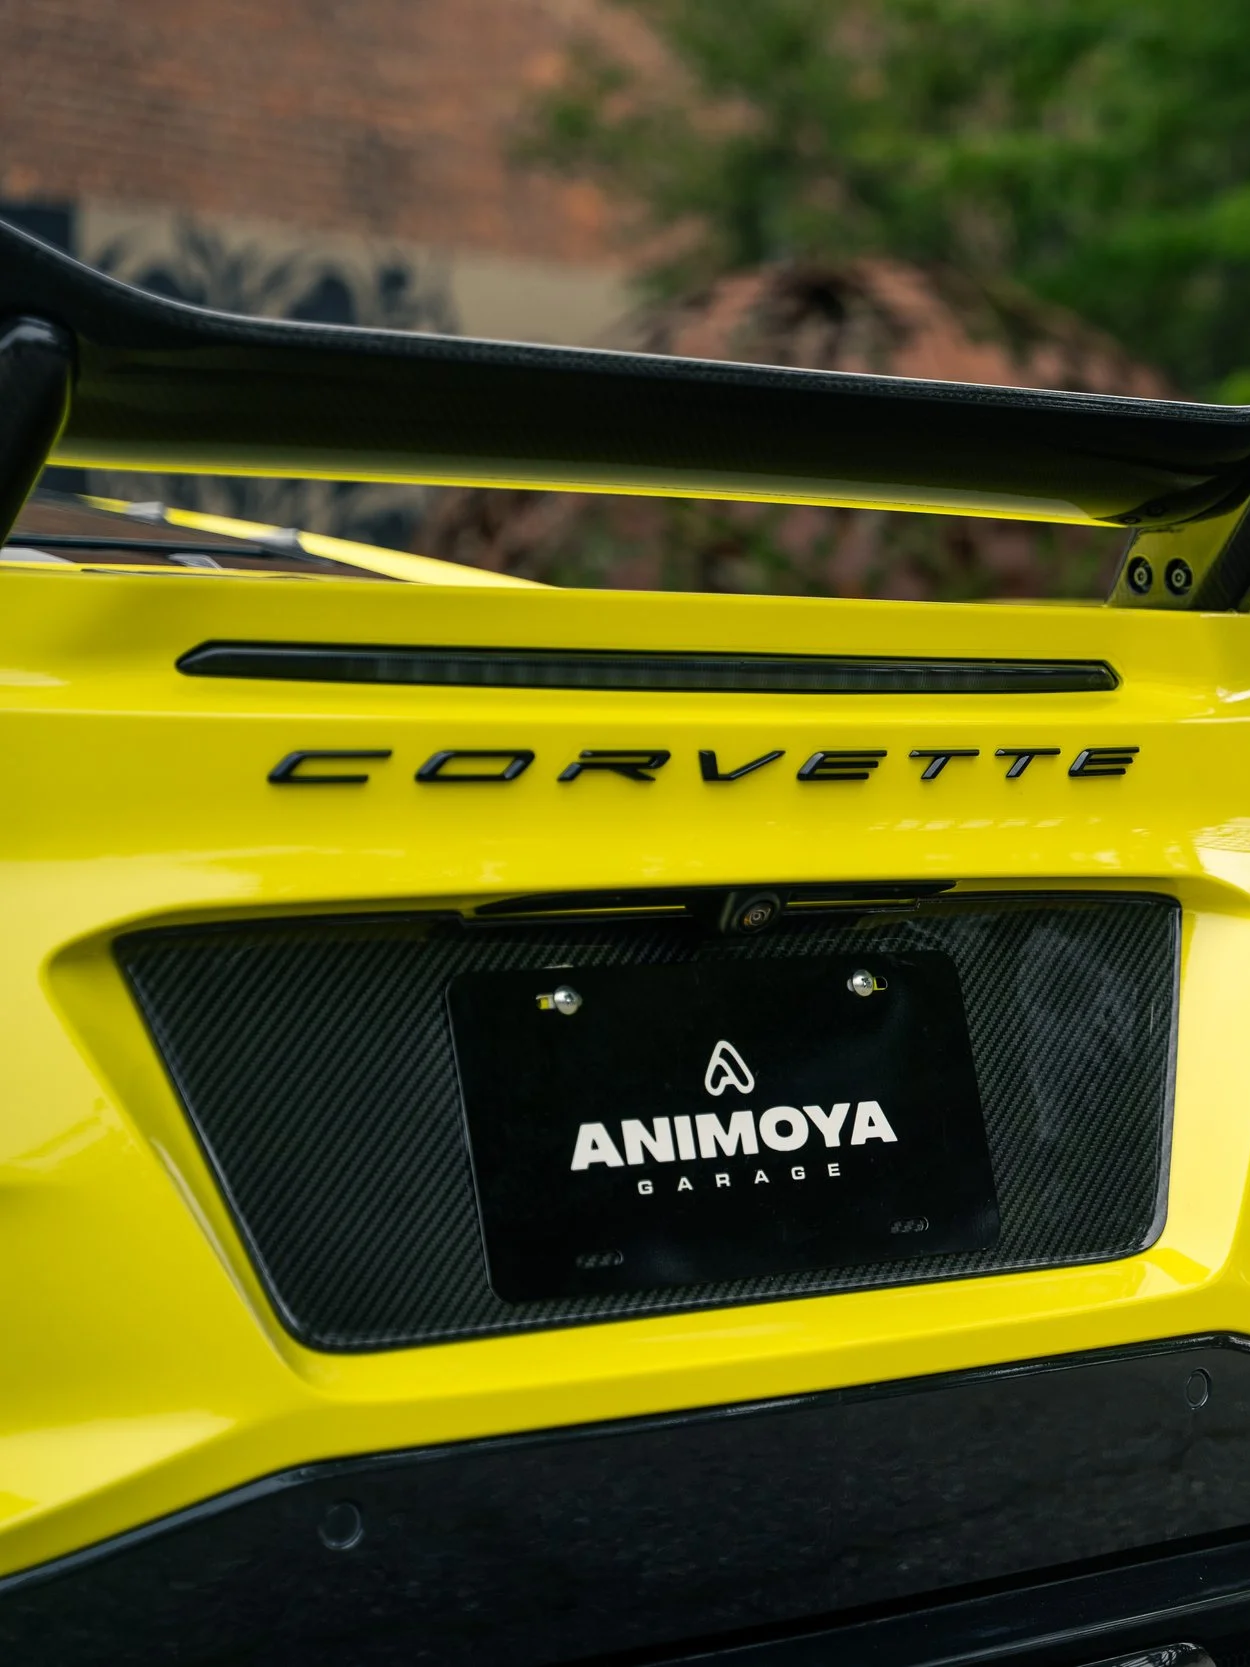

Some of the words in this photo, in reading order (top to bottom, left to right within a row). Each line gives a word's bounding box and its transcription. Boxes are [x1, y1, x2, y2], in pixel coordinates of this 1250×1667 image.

[267, 747, 1140, 786] CORVETTE
[570, 1100, 899, 1171] ANIMOYA
[637, 1162, 841, 1195] GARAGE
